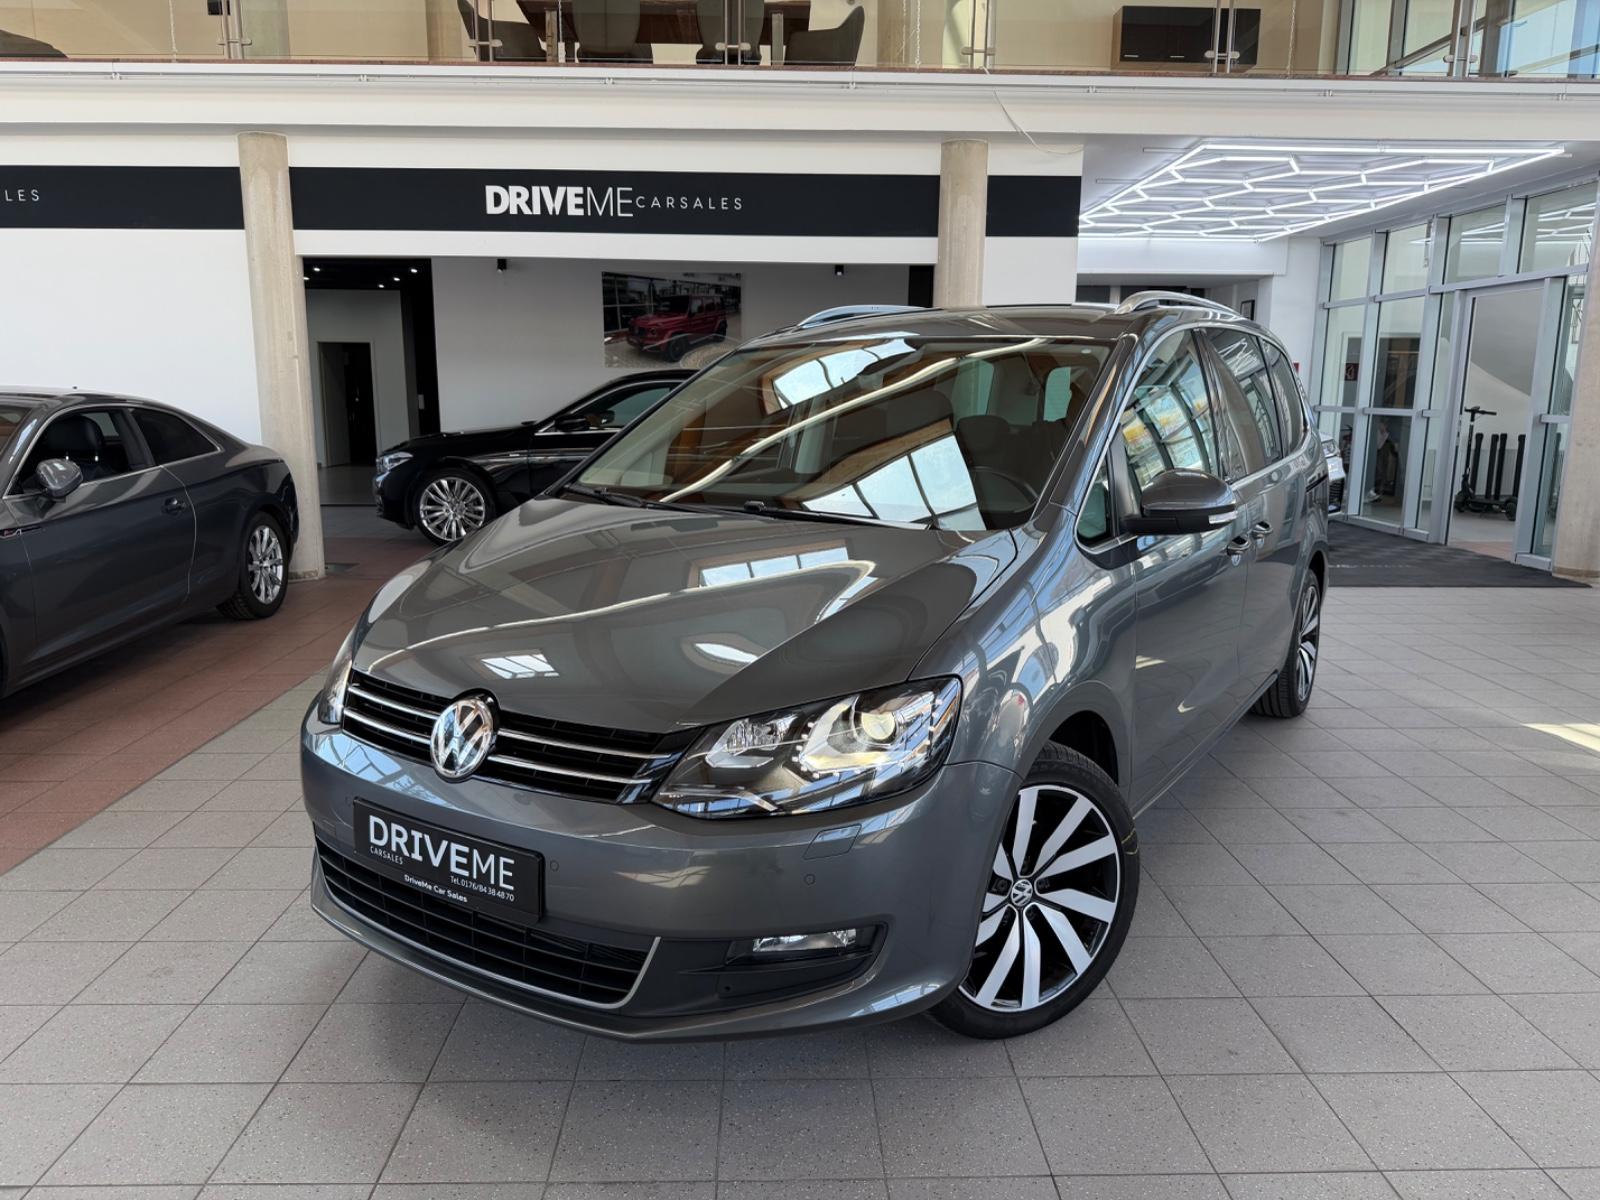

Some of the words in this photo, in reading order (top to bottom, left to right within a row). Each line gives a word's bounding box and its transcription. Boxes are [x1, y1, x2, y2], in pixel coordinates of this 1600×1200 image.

[635, 195, 743, 210] CARSALES
[369, 815, 515, 891] DRIVEME
[370, 845, 404, 865] CARSALES
[404, 874, 433, 891] DriveMe
[433, 885, 446, 895] Car
[447, 889, 468, 903] Sales
